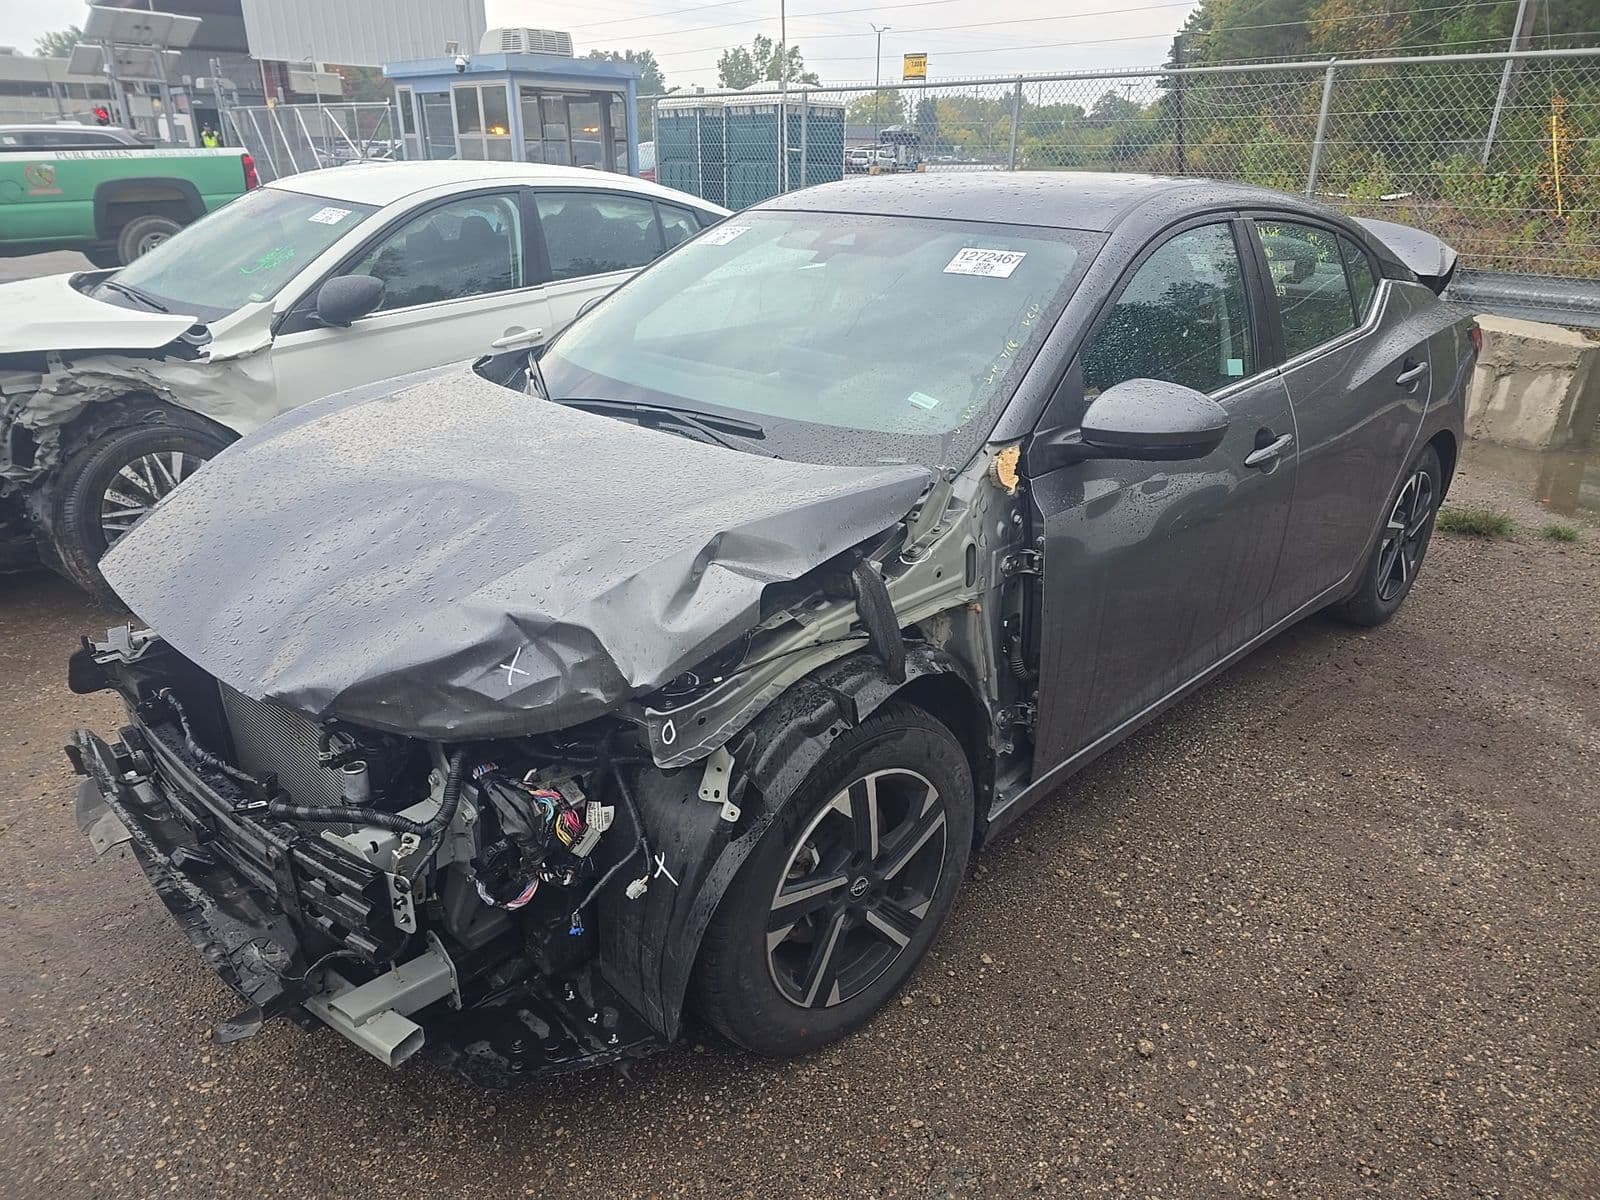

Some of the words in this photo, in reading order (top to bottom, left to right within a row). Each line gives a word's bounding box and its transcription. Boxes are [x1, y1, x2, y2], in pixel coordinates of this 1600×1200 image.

[55, 151, 88, 160] PURE
[91, 150, 133, 159] GREEN
[960, 250, 1024, 264] 1272467
